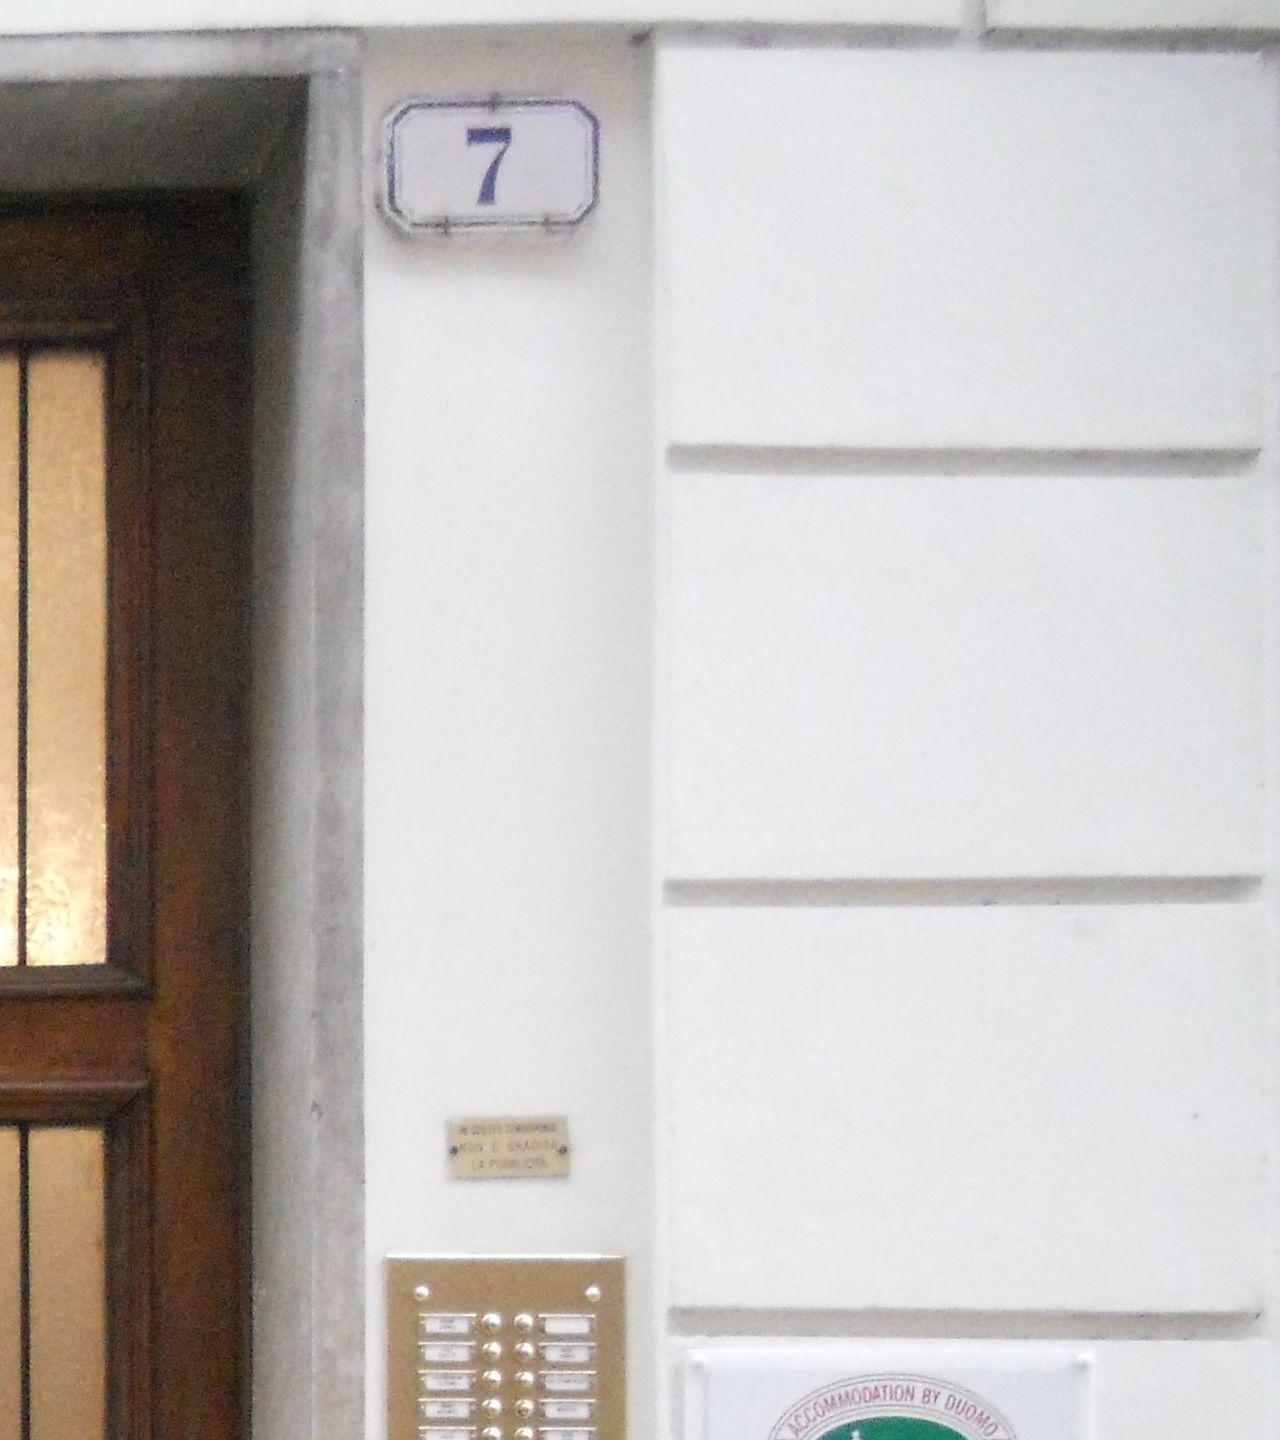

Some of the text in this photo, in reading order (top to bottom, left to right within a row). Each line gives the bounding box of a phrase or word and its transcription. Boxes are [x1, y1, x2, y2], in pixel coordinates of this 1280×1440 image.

[465, 126, 513, 206] 7
[787, 1384, 1000, 1438] ACCOMMODATION BY DUOMO
